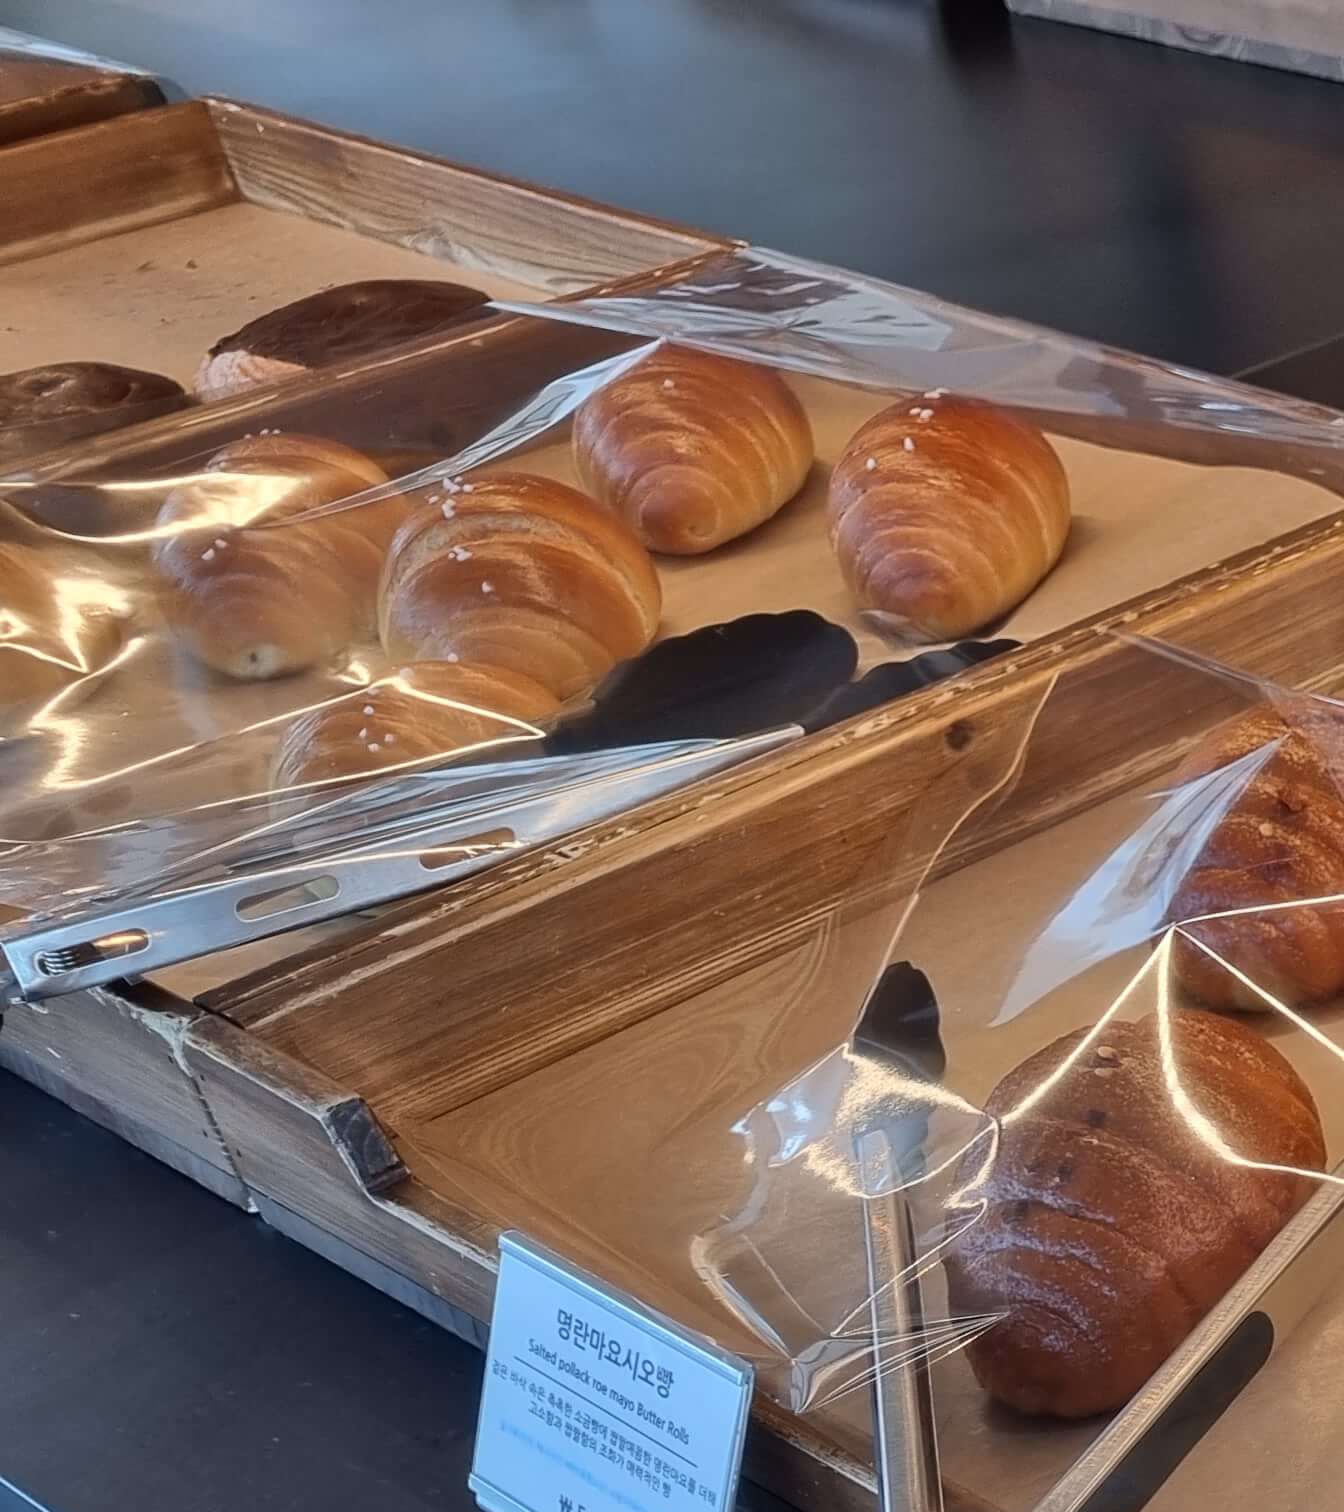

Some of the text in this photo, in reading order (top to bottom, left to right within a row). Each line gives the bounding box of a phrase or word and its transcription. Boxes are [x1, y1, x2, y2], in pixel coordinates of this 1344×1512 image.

[528, 1338, 690, 1445] Salted pollack roe mayo Butter Rolls
[557, 1308, 675, 1399] 명란마요시오빵
